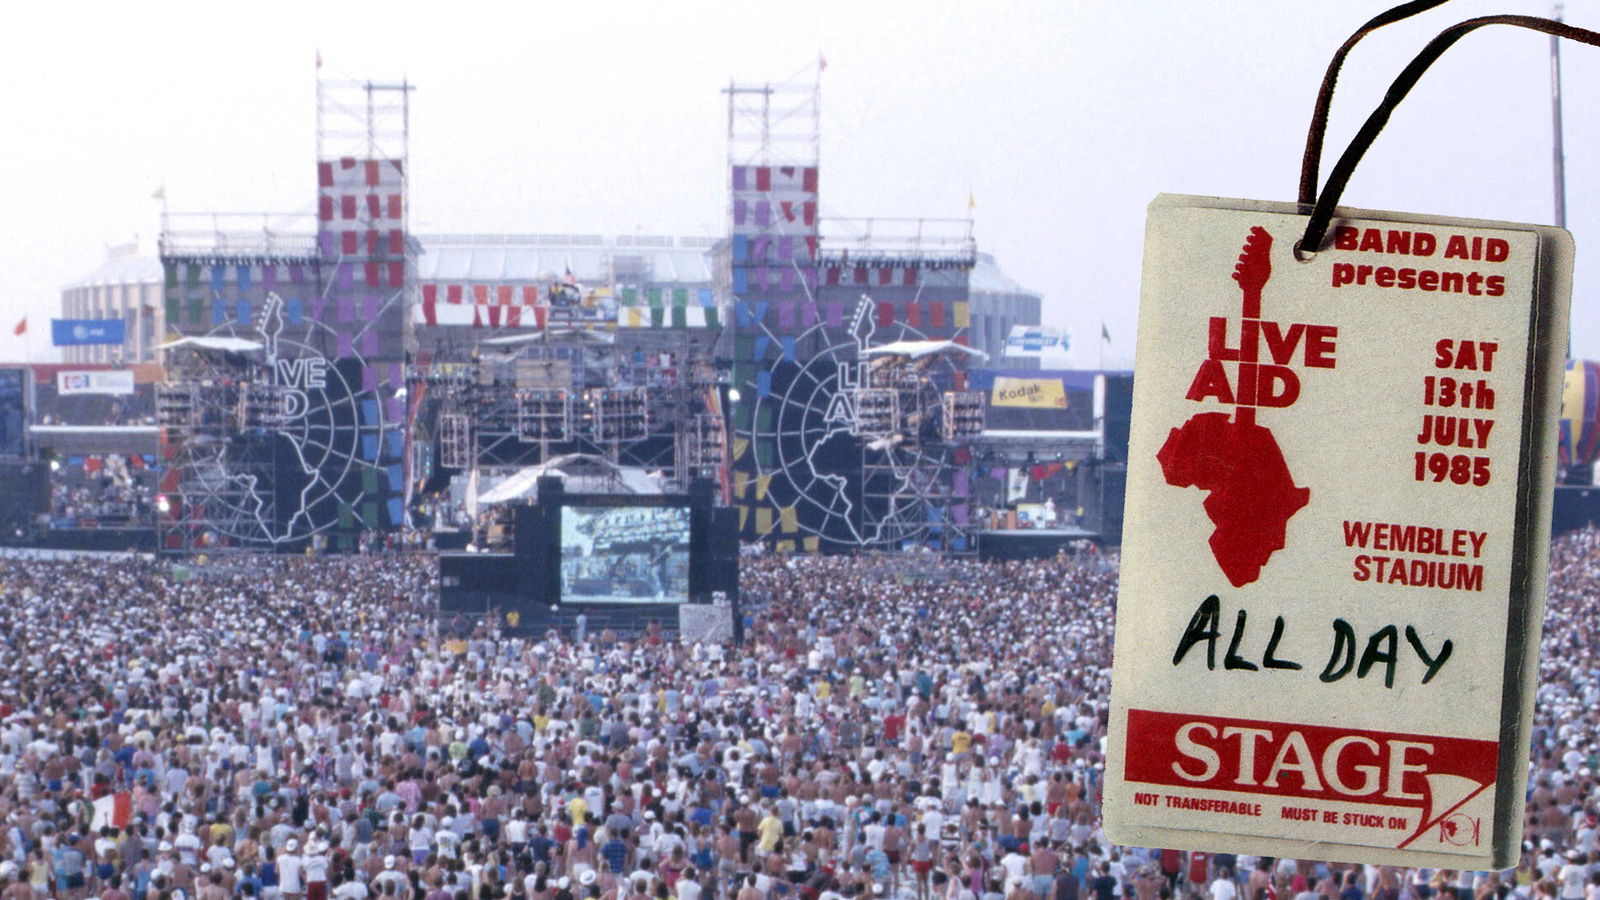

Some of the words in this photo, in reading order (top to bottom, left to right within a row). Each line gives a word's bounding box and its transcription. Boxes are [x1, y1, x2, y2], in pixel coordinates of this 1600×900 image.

[1335, 226, 1437, 257] BAND
[1443, 235, 1510, 263] AID
[1331, 262, 1506, 297] presents
[1208, 316, 1338, 369] LIVE
[1435, 339, 1499, 372] SAT
[999, 383, 1042, 401] Kodak
[1185, 359, 1301, 409] AID
[1423, 375, 1496, 411] 13th
[1417, 415, 1495, 449] JULY
[1414, 451, 1491, 487] 1985
[1343, 520, 1488, 559] WEMBLEY
[1353, 556, 1484, 592] STADIUM
[1172, 594, 1302, 671] ALL
[1319, 618, 1454, 689] DAY
[1171, 721, 1435, 801] STAGE
[1134, 792, 1161, 806] NOT
[1165, 795, 1262, 817] TRANSFERABLE
[1280, 806, 1319, 822] MUST
[1322, 810, 1339, 825] BE
[1343, 813, 1385, 829] STUCK
[1388, 816, 1408, 831] ON
